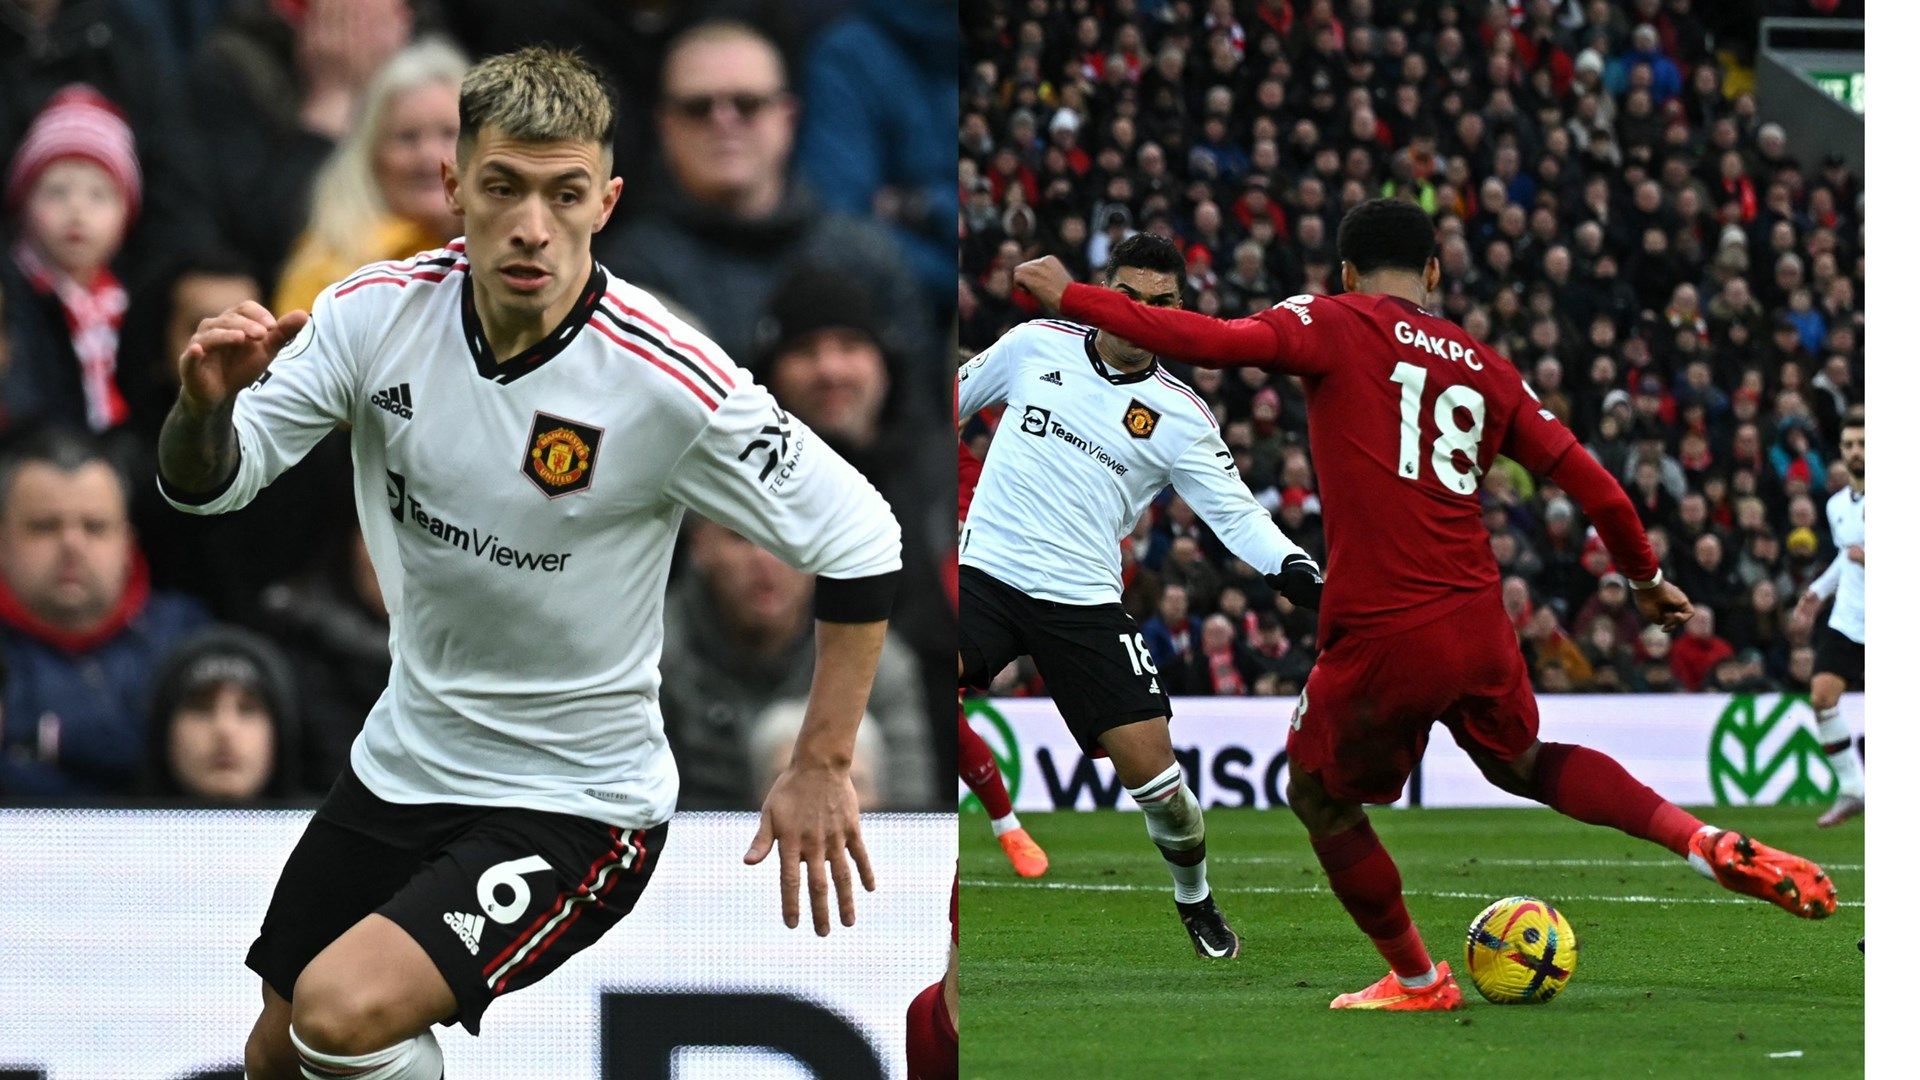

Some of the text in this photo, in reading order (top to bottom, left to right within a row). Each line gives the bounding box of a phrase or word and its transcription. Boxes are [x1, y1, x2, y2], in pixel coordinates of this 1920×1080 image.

[371, 393, 414, 421] adidas
[1390, 361, 1486, 496] 18
[540, 431, 586, 458] MANCHESTER
[1050, 421, 1129, 477] TeamViewer
[540, 468, 573, 483] UNITED
[407, 494, 571, 572] TeamViewer
[1119, 632, 1159, 675] 18
[476, 854, 553, 924] 6
[443, 912, 480, 956] adidas
